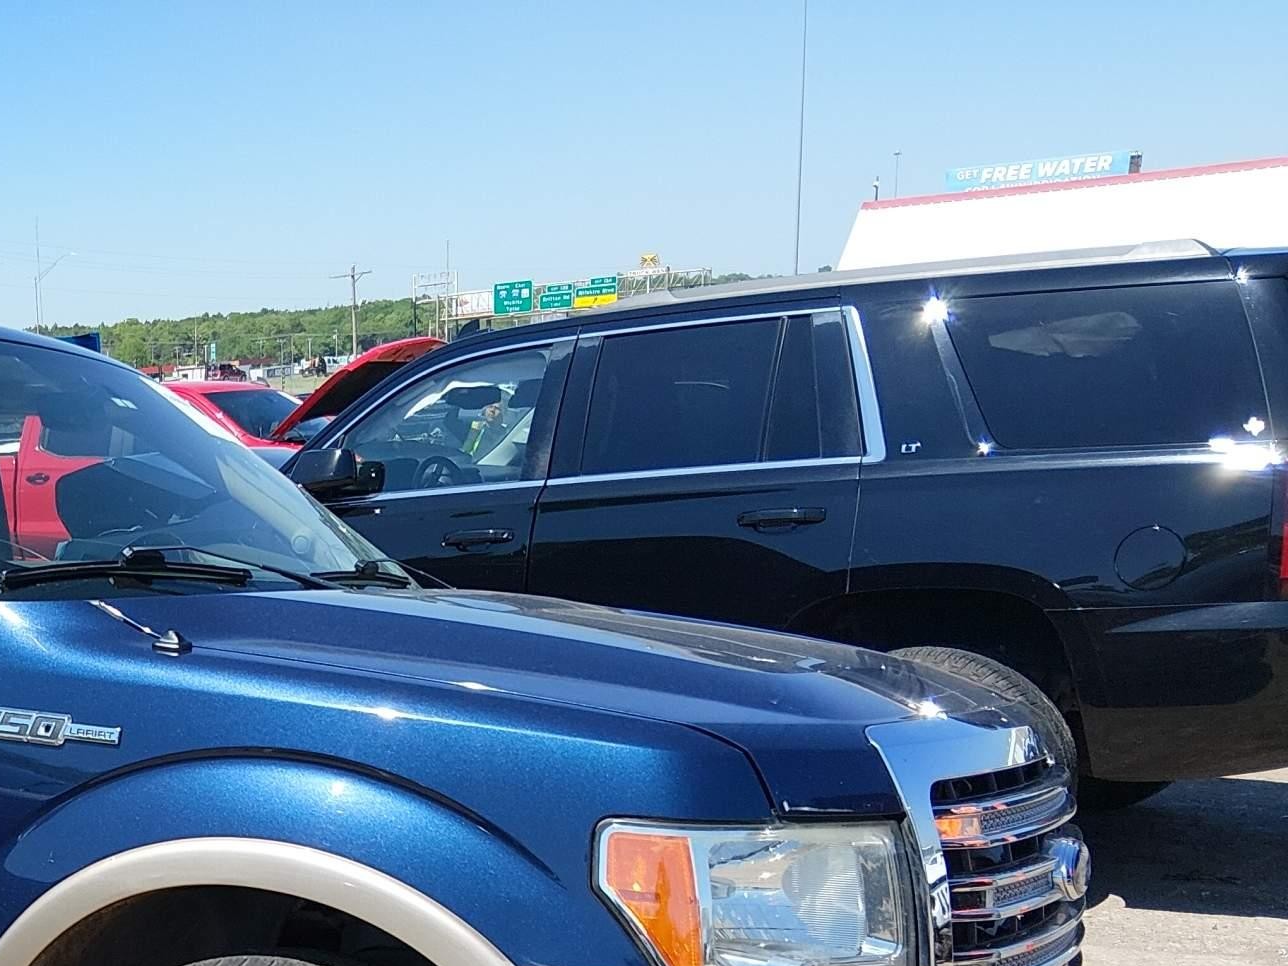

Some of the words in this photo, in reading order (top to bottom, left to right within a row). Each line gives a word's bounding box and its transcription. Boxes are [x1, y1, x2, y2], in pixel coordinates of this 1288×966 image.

[956, 169, 979, 181] GET
[980, 163, 1032, 183] FREE
[1038, 154, 1112, 178] WATER
[901, 441, 921, 453] LT
[69, 727, 115, 739] LARIAT
